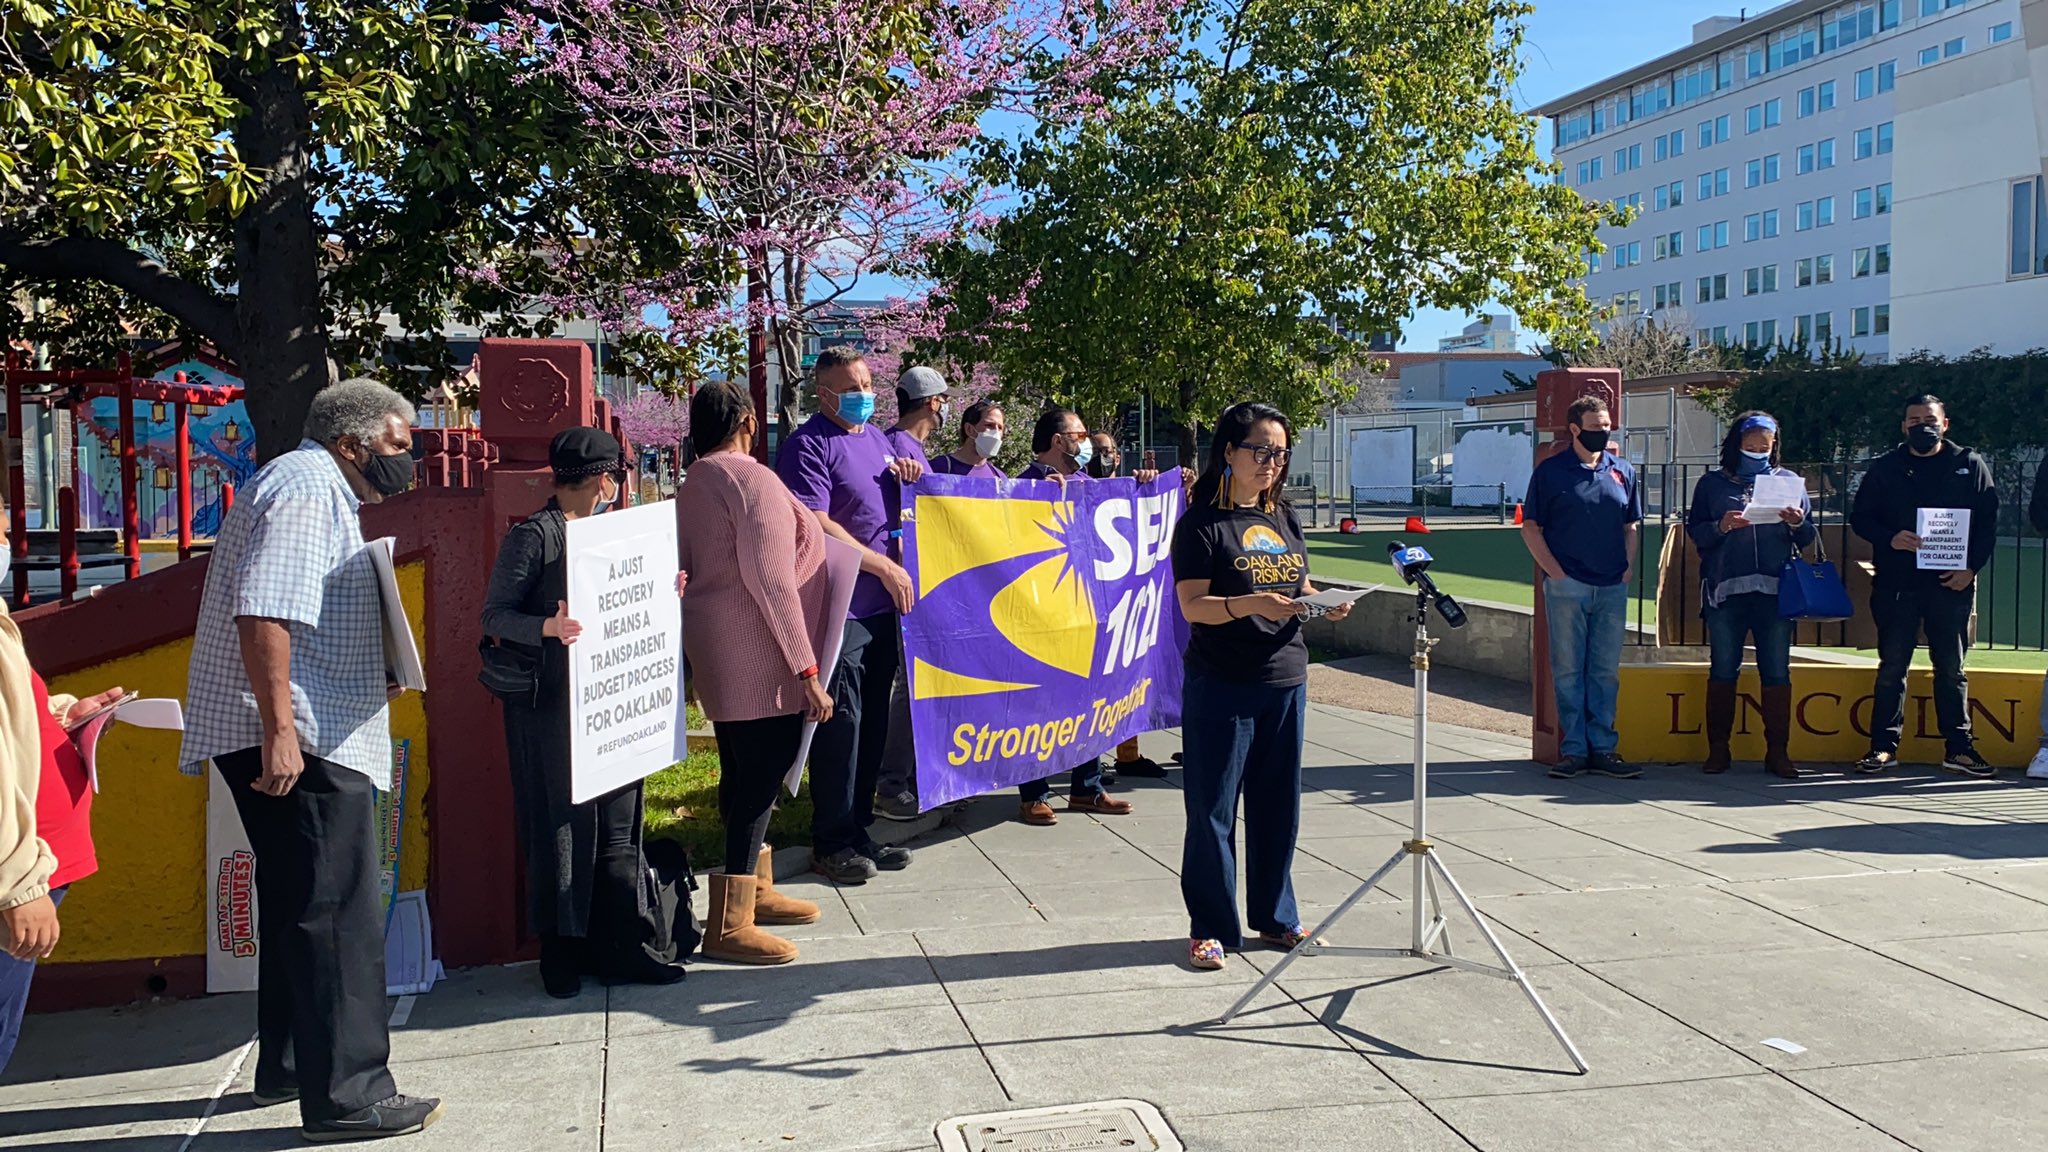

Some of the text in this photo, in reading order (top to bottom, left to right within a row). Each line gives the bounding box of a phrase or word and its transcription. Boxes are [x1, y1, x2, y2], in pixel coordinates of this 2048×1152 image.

[1093, 487, 1179, 581] SEU
[608, 555, 643, 582] A JUST
[1234, 553, 1304, 571] OAKLAND
[1252, 567, 1299, 584] RISING
[598, 580, 654, 614] RECOVERY
[603, 609, 651, 641] MEANS A
[590, 631, 666, 673] TRANSPARENT
[583, 656, 675, 705] BUDGET PROCESS
[586, 686, 673, 736] FOR OAKLAND
[1666, 692, 2021, 743] LNCLN
[597, 720, 667, 756] #REFUNDOAKLAND
[947, 713, 1086, 766] Stronger
[390, 807, 400, 848] MINUTE
[222, 859, 231, 872] IN
[220, 911, 229, 920] A
[233, 853, 253, 954] 5 MINUTES!
[221, 922, 231, 949] MAKE
